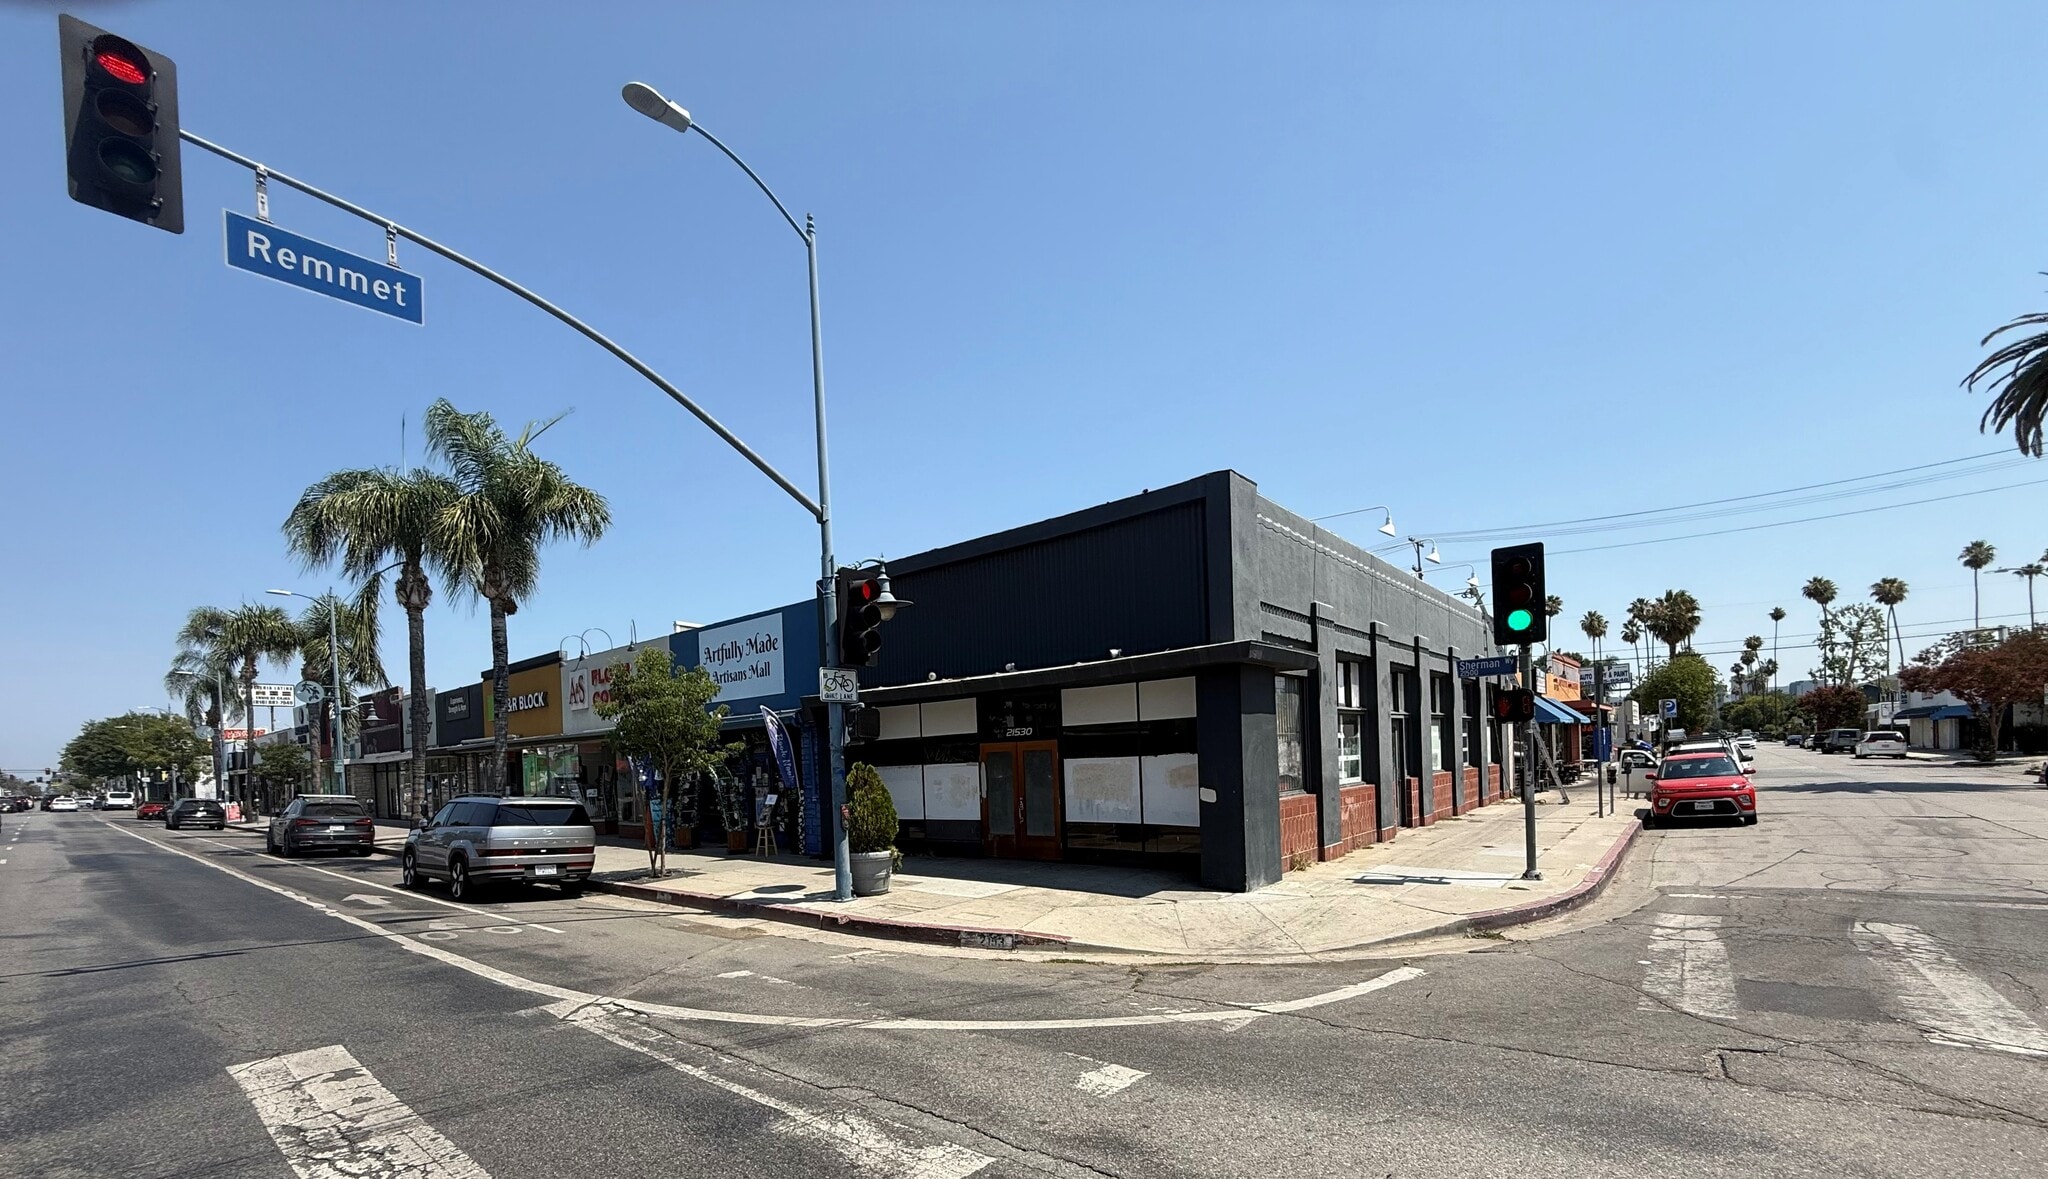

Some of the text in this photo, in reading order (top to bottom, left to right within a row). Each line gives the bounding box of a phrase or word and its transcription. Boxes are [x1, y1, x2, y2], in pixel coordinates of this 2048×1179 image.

[247, 229, 406, 307] Remmet
[703, 632, 779, 667] Artfully Made
[713, 660, 771, 684] Artisans Mall
[1459, 657, 1514, 670] Sherman Wy
[1613, 670, 1628, 678] PAINT
[519, 691, 545, 710] BLOCK
[1005, 727, 1033, 737] 21530
